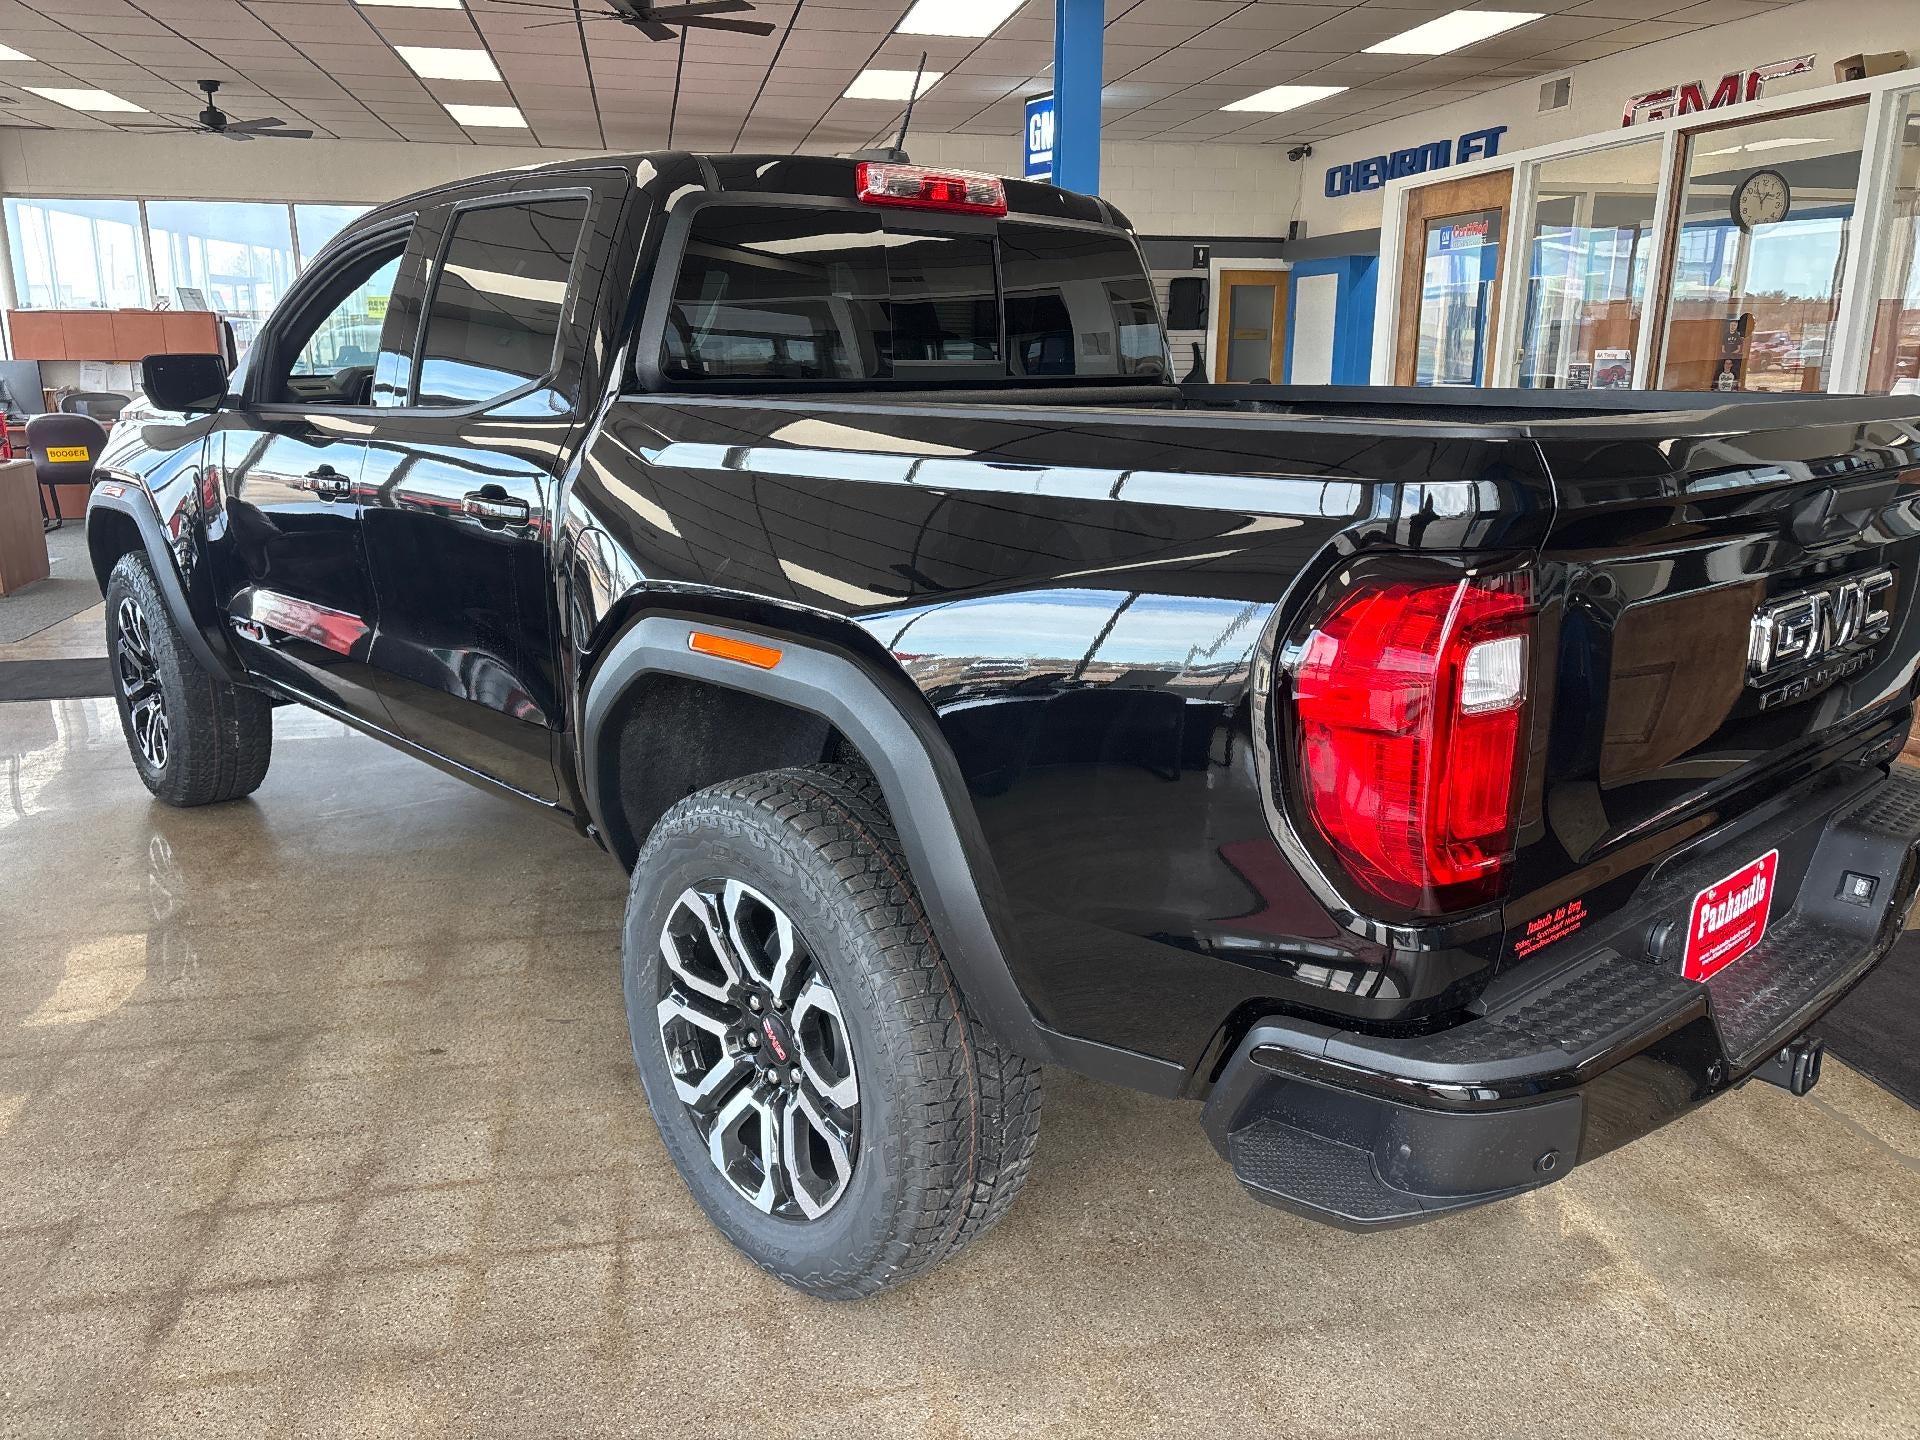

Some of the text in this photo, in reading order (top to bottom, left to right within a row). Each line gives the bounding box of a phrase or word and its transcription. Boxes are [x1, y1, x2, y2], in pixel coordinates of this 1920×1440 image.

[1622, 53, 1816, 127] GMC
[1325, 126, 1507, 197] CHEVROLET
[49, 450, 86, 458] BOOGER
[1748, 571, 1893, 674] GMC
[1759, 648, 1875, 711] CANYON
[1698, 872, 1766, 940] Panhandle
[763, 1018, 786, 1060] GMC
